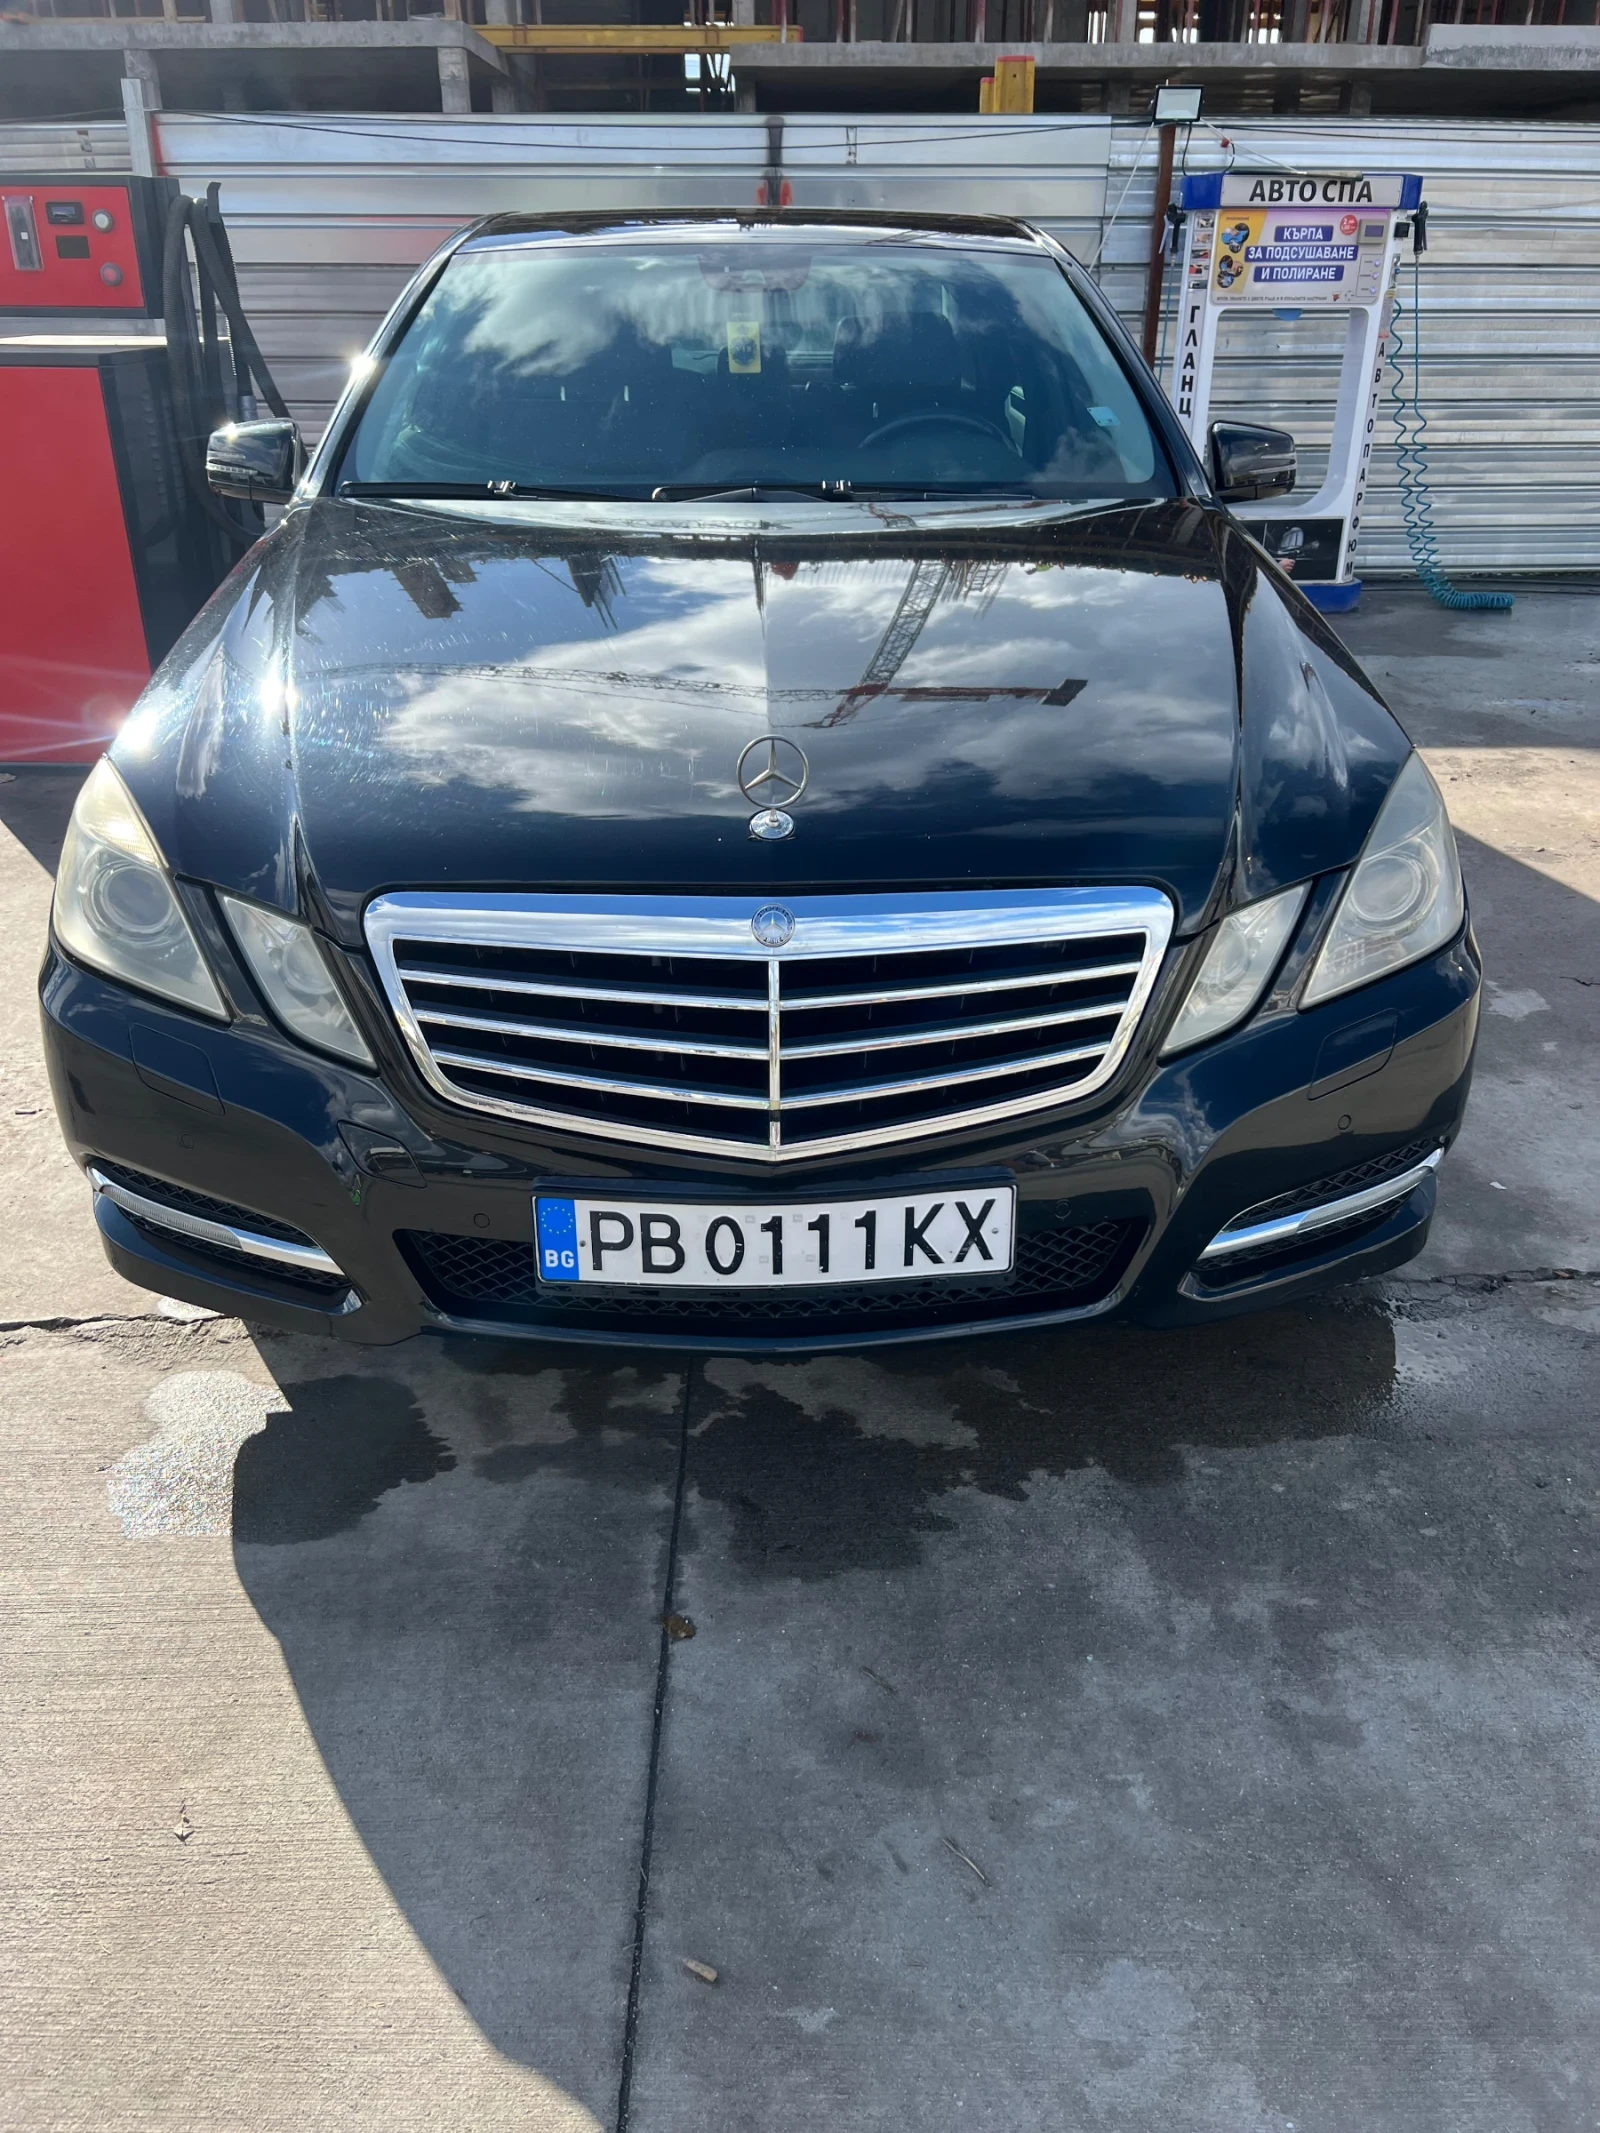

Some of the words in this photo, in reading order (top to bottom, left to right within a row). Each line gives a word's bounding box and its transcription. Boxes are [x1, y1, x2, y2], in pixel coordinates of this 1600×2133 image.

[1249, 179, 1317, 202] АВТО
[1322, 180, 1373, 203] СПА
[1283, 227, 1323, 241] КЪРПА
[1248, 246, 1263, 259] ЗА
[1265, 246, 1354, 261] ПОДСУШАВАНЕ
[1261, 267, 1270, 280] И
[1273, 267, 1336, 280] ПОЛИРАНЕ
[1179, 305, 1201, 419] ГЛАНЦ
[1345, 341, 1385, 575] АВТОПАРФЮМ
[544, 1249, 575, 1268] BG
